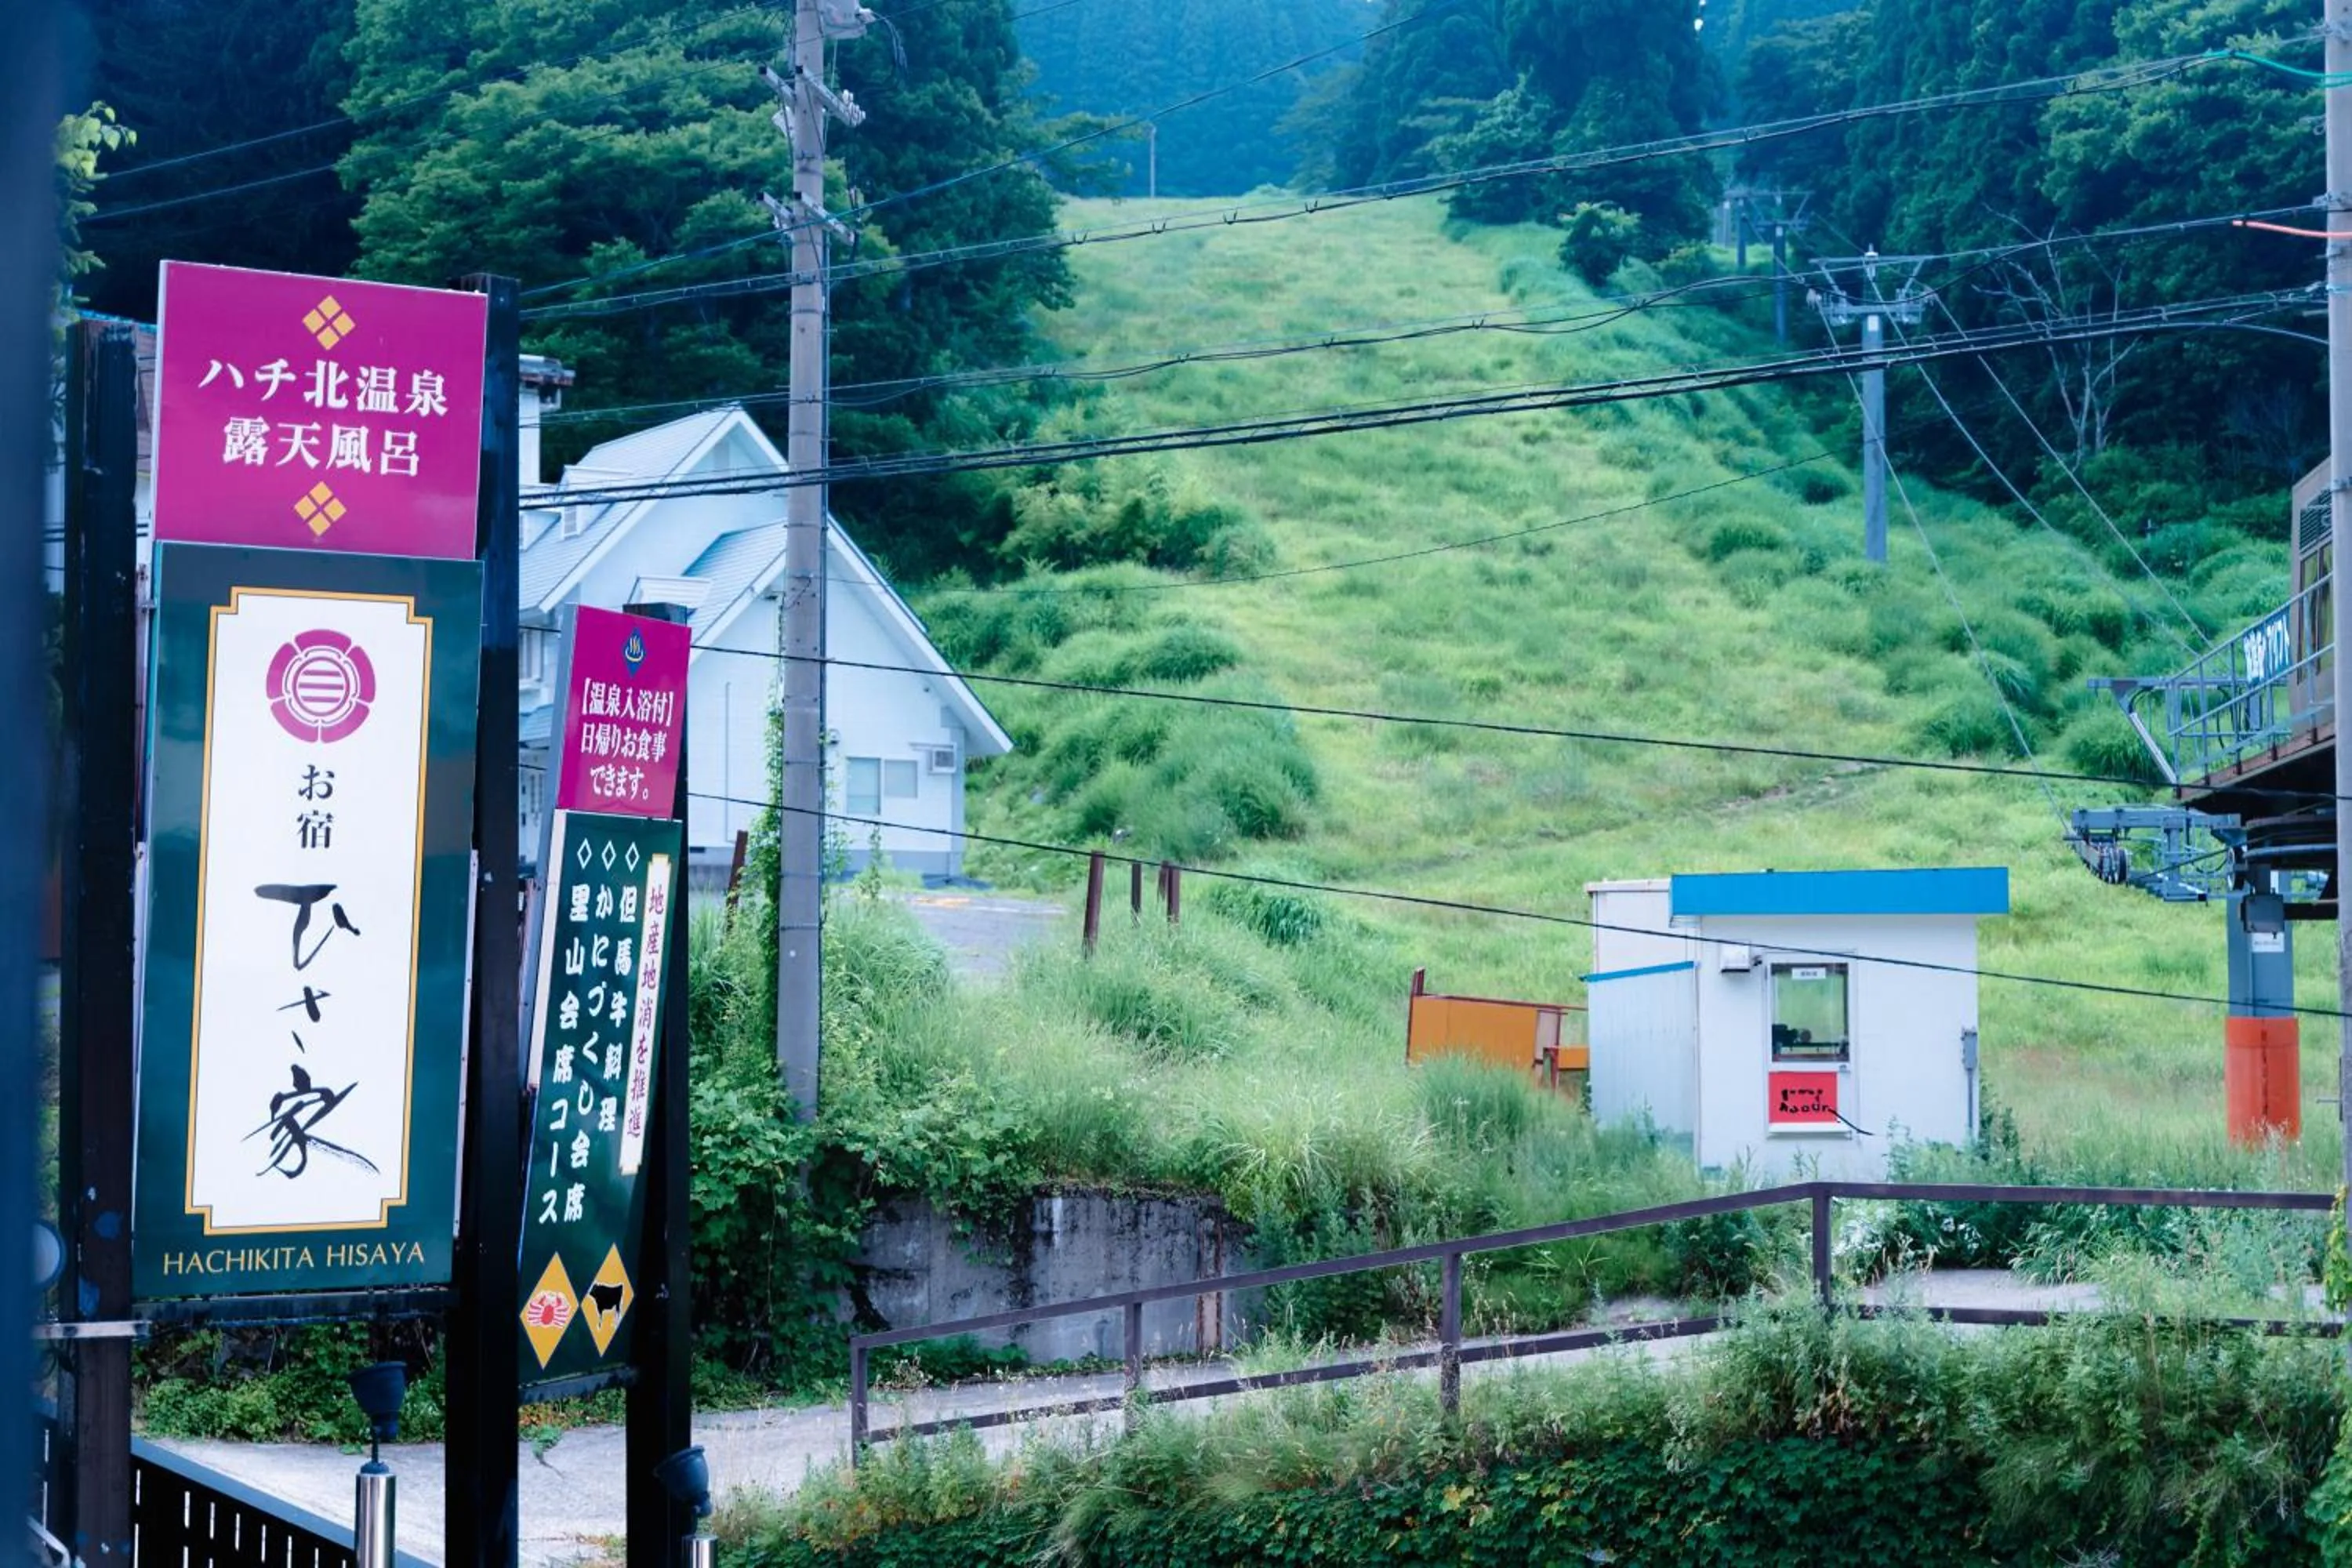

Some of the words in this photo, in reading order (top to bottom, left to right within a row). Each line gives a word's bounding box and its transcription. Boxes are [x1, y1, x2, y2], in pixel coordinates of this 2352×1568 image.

[198, 358, 448, 417] ハチ北温泉
[223, 416, 420, 477] 露天風呂
[580, 721, 666, 763] 日帰りお食事
[590, 763, 649, 800] できます。
[296, 764, 336, 850] お宿
[241, 883, 381, 1179] ひさ家
[597, 884, 637, 1132] 但馬牛料理
[626, 882, 665, 1139] 地産地消を推進
[538, 883, 590, 1225] 里山会席コース
[563, 884, 614, 1223] かにづくし会席
[162, 1246, 314, 1276] HACHIKITA
[326, 1240, 425, 1268] HISAYA
